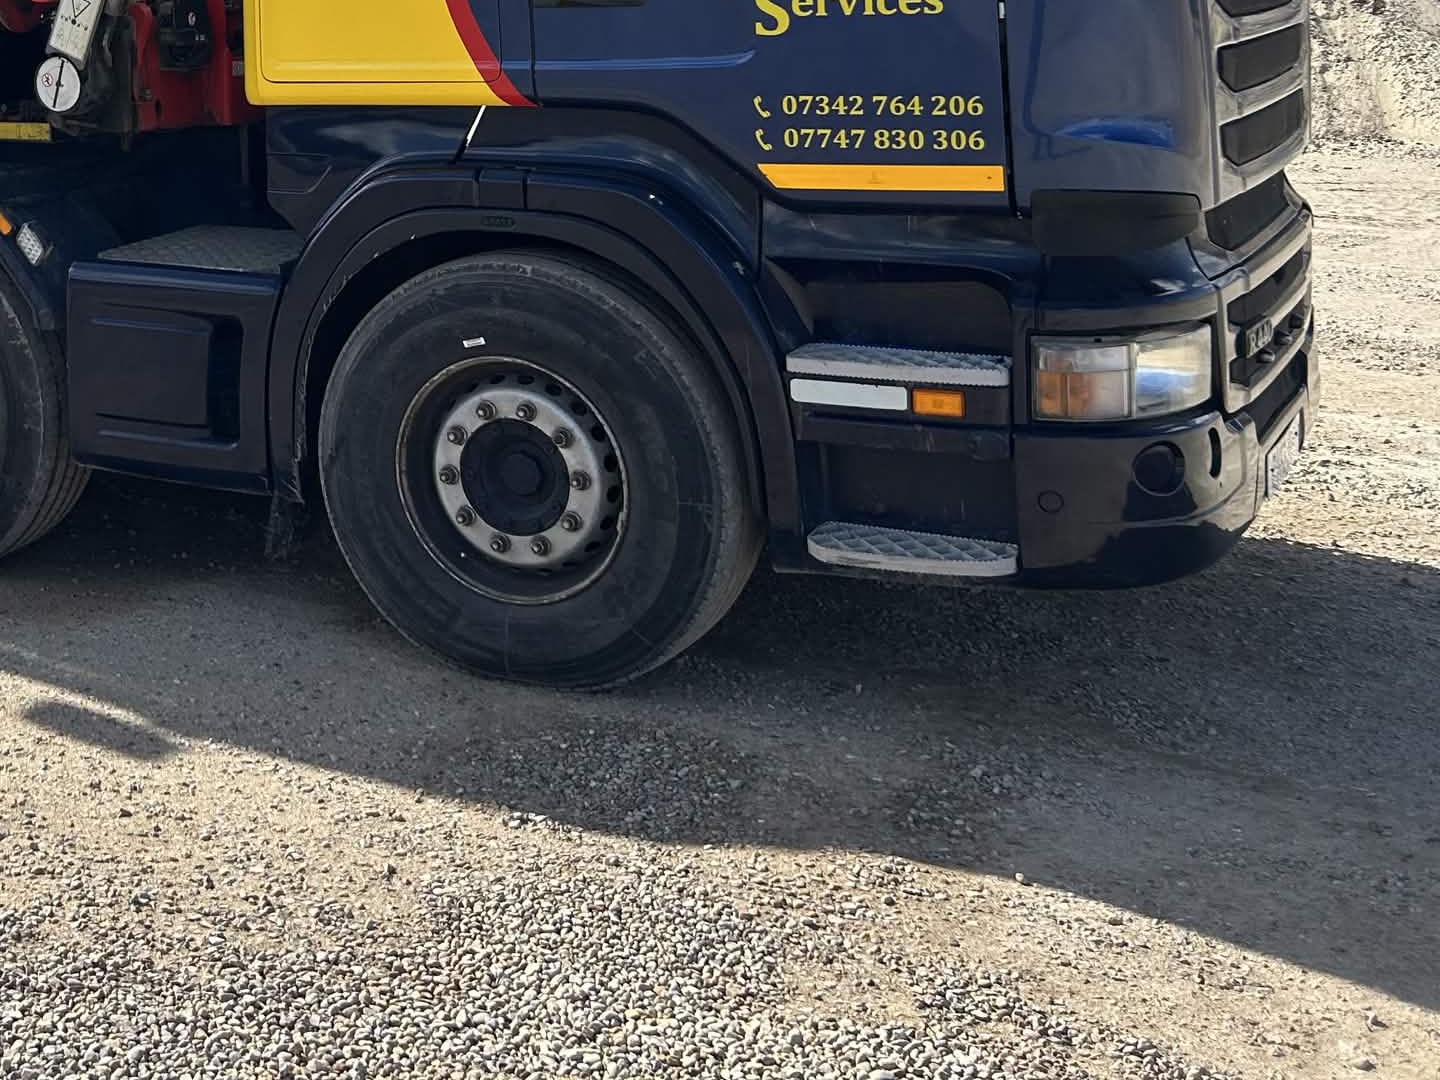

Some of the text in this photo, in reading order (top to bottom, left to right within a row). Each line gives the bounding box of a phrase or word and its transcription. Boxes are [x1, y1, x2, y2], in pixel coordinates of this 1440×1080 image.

[781, 95, 984, 116] 07342 764 206
[783, 128, 986, 151] 07747 830 306
